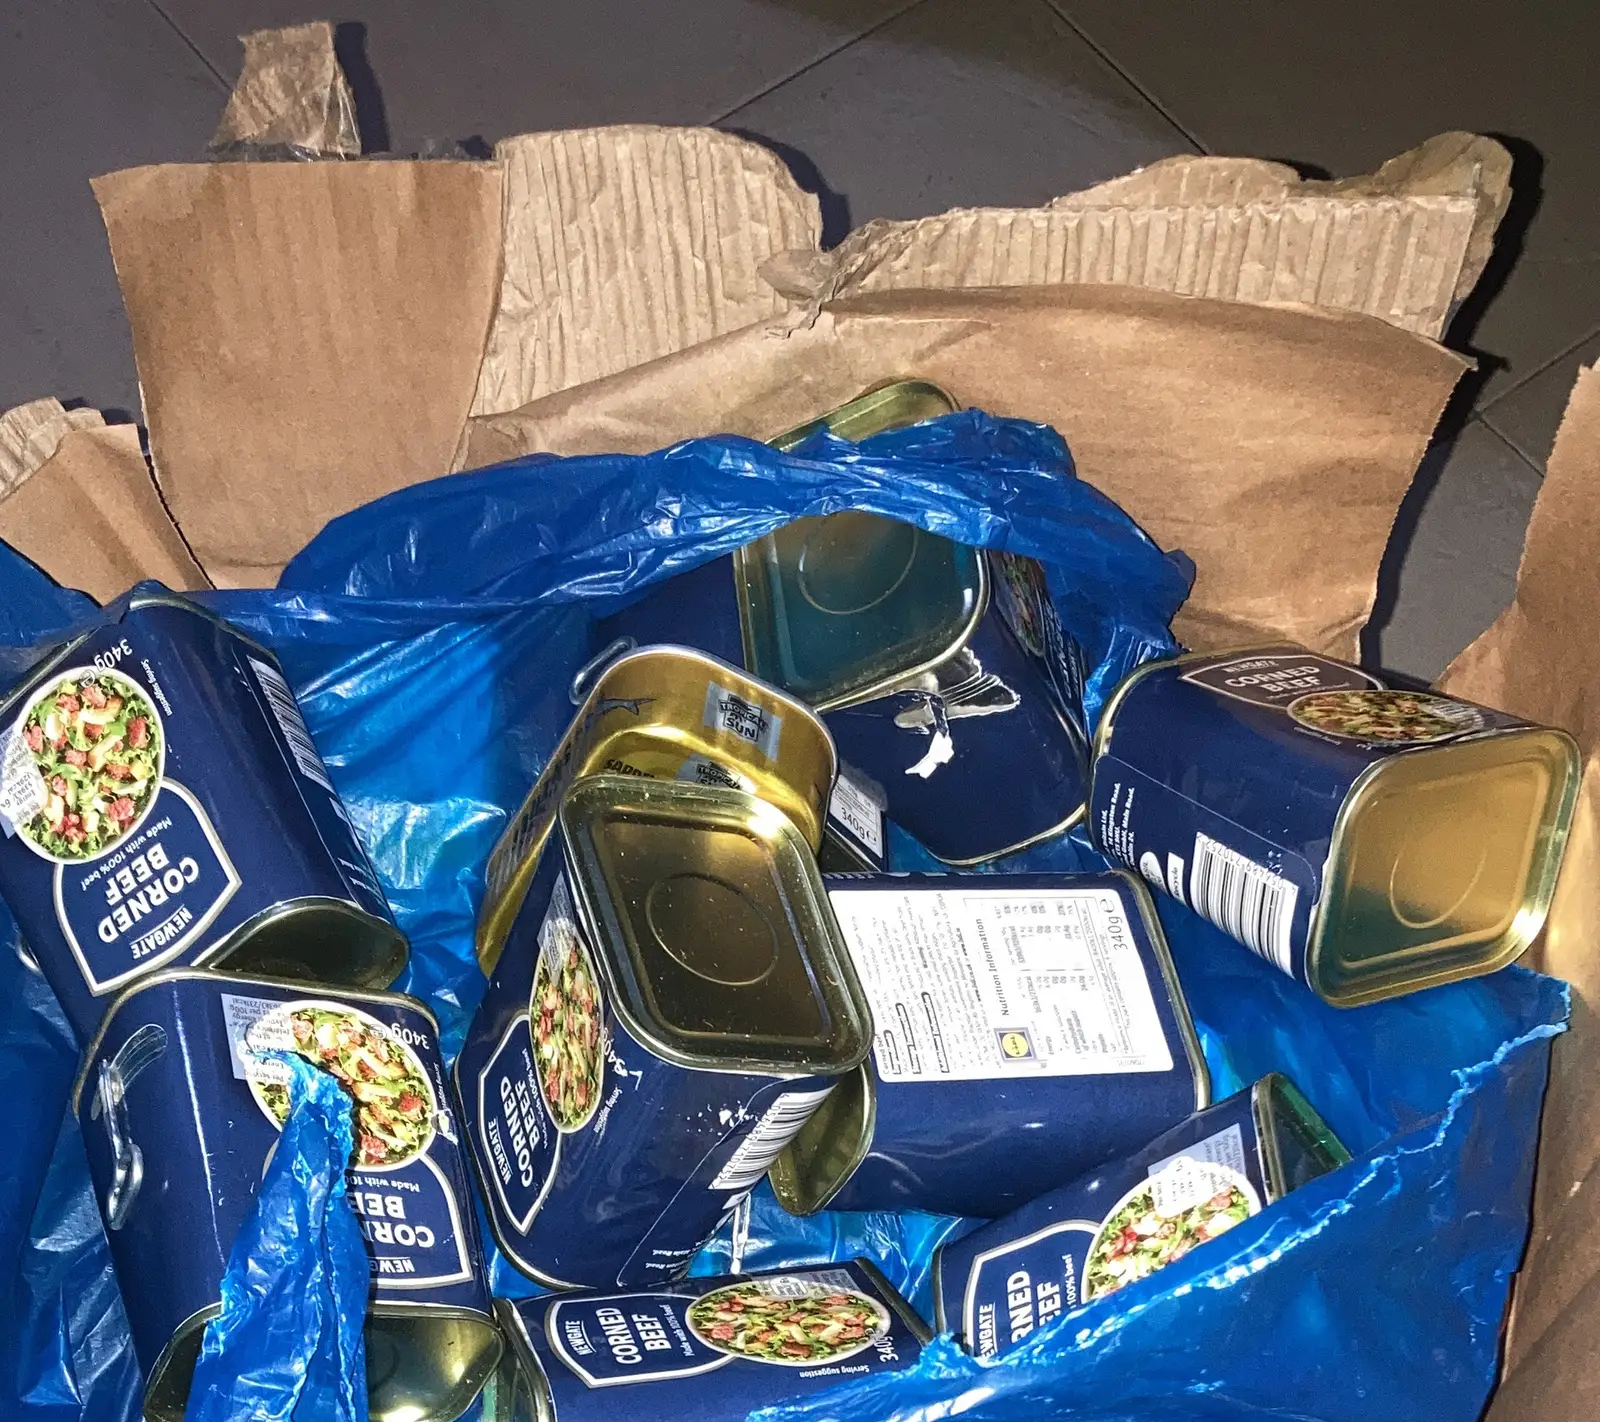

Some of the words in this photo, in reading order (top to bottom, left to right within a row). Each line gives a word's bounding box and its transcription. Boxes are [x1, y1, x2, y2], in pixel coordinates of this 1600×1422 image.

[94, 638, 133, 672] 340g
[140, 658, 156, 684] Serving
[151, 682, 173, 716] suggestion
[1225, 666, 1320, 687] CORNED
[1260, 676, 1321, 692] BEEF
[726, 717, 756, 738] SUN
[1110, 783, 1121, 804] Road,
[1125, 787, 1135, 809] Road,
[146, 816, 173, 838] Made
[841, 807, 865, 840] 340g
[125, 836, 147, 854] with
[100, 848, 127, 876] 100%
[104, 842, 170, 906] BEEF
[81, 869, 101, 891] beef
[98, 856, 199, 943] CORNED
[130, 906, 193, 960] NEWGATE
[976, 918, 998, 972] Information
[1107, 916, 1128, 951] 340g
[992, 974, 1010, 1016] Nutrition
[391, 1022, 430, 1050] 340g
[515, 1080, 540, 1151] BEEF
[500, 1076, 534, 1187] CORNED
[488, 1117, 512, 1185] NEWGATE
[364, 1176, 390, 1188] with
[391, 1180, 420, 1193] Made
[360, 1220, 435, 1249] CORN
[370, 1259, 416, 1273] NEWG
[1061, 1253, 1075, 1278] beef
[1037, 1281, 1061, 1327] EEF
[1065, 1276, 1077, 1305] 100%
[1007, 1270, 1034, 1344] RNED
[565, 1320, 593, 1356] NEWGATE
[595, 1307, 643, 1364] CORNED
[631, 1314, 672, 1351] BEEF
[979, 1303, 996, 1359] EWGATE
[873, 1336, 899, 1362] 340g
[799, 1366, 840, 1378] suggestion
[840, 1364, 870, 1374] Serving
